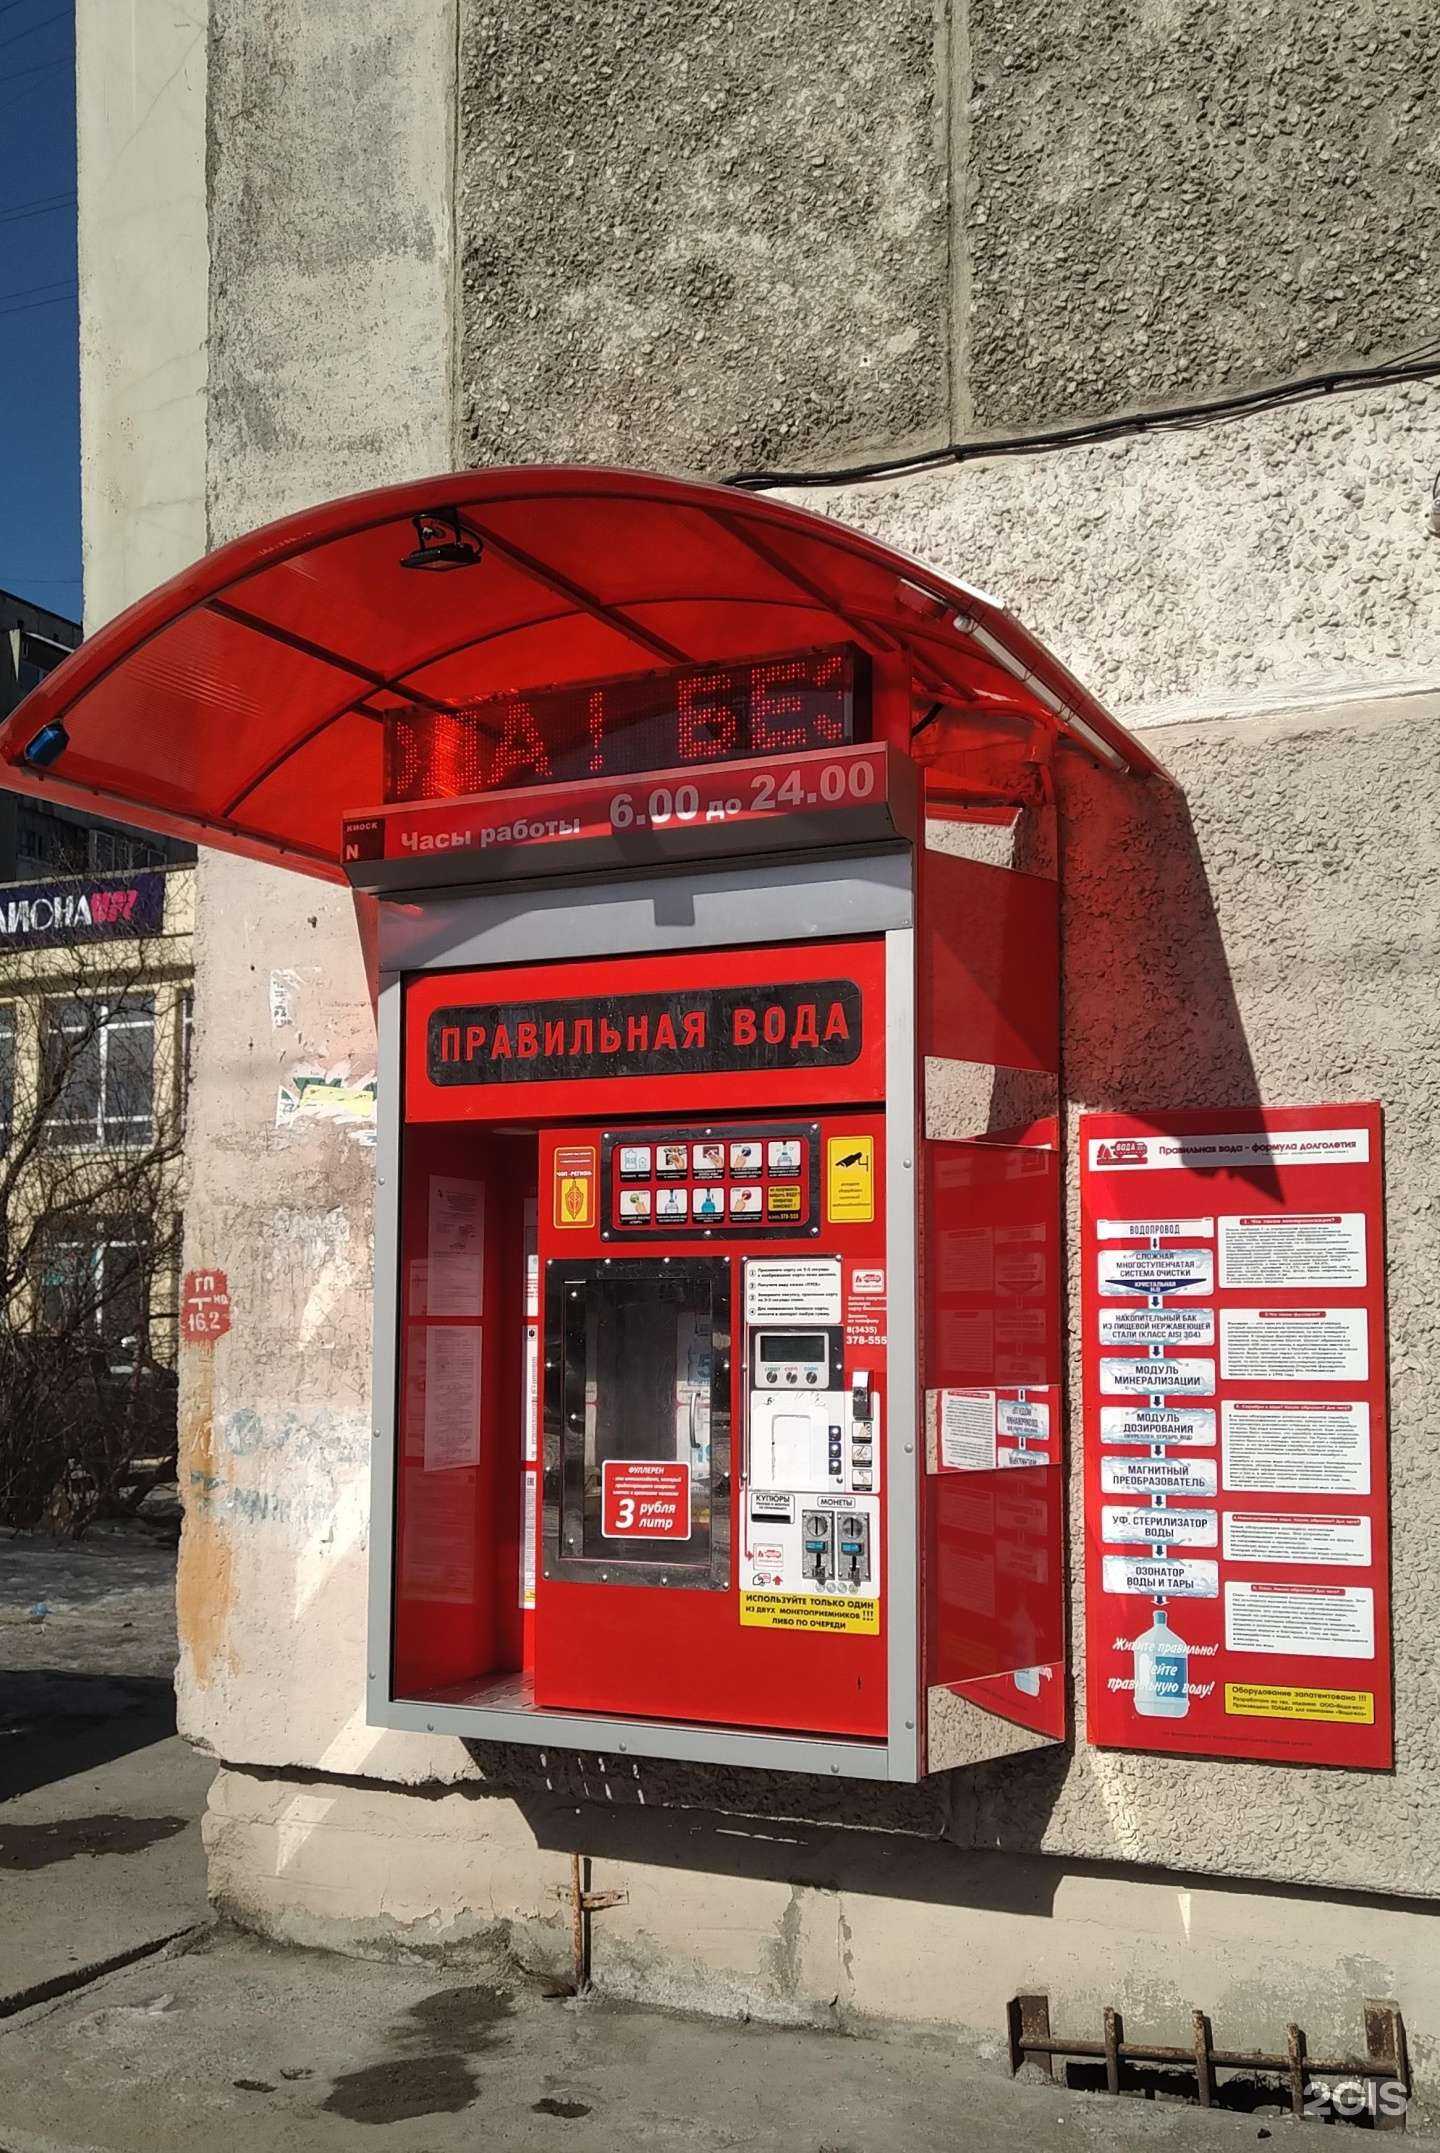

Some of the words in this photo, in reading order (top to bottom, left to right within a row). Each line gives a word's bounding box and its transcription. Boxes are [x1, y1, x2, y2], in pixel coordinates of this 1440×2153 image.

[401, 830, 471, 851] Часы
[480, 817, 581, 847] работы
[610, 784, 699, 827] 6.00
[706, 798, 742, 821] до
[750, 760, 874, 810] 24.00
[440, 1010, 706, 1063] ПРАВИЛЬНАЯ
[733, 1002, 850, 1049] ВОДА
[1159, 1145, 1216, 1156] Правильная
[1219, 1145, 1243, 1153] вода
[1251, 1143, 1297, 1153] формула
[1300, 1141, 1356, 1151] долголетия
[1129, 1224, 1180, 1235] ВОДОПРОВОД
[1116, 1261, 1195, 1269] МНОГОСТУПЕНЧАТАЯ
[1156, 1269, 1191, 1277] ОЧИСТКИ
[1116, 1313, 1180, 1321] НАКОПИТЕЛЬНЫЙ
[1114, 1322, 1149, 1330] ПИЩЕВОЙ
[1152, 1322, 1210, 1330] НЕРЖАВЕЮЩЕЙ
[846, 1336, 887, 1345] 378-555
[1136, 1366, 1179, 1375] МОДУЛЬ
[1114, 1376, 1200, 1386] МИНЕРАЛИЗАЦИИ
[1136, 1413, 1179, 1423] МОДУЛЬ
[1123, 1424, 1193, 1433] ДОЗИРОВАНИЯ
[1128, 1465, 1189, 1475] МАГНИТНЫЙ
[1113, 1475, 1205, 1487] ПРЕОБРАЗОВАТЕЛЬ
[820, 1498, 853, 1506] МОНЕТЫ
[615, 1498, 635, 1528] 3
[640, 1501, 676, 1515] рубля
[639, 1518, 673, 1530] литр
[1133, 1516, 1208, 1528] СТЕРИЛИЗАТОР
[1145, 1528, 1174, 1537] ВОДЫ
[1135, 1567, 1184, 1577] ОЗОНАТОР
[1127, 1577, 1155, 1587] ВОДЫ
[1158, 1578, 1165, 1587] И
[1167, 1579, 1194, 1588] ТАРЫ
[746, 1594, 807, 1605] ИСПОЛЬЗУЙТЕ
[810, 1598, 845, 1607] ТОЛЬКО
[847, 1601, 874, 1609] ОДИН
[780, 1608, 860, 1619] МОНЕТОПРИЕМНИКОВ
[810, 1620, 846, 1629] ОЧЕРЕДИ
[1158, 1643, 1219, 1656] правильно!
[1182, 1681, 1215, 1699] воду!
[1232, 1686, 1292, 1697] Оборудование
[1294, 1692, 1356, 1701] запатентовано
